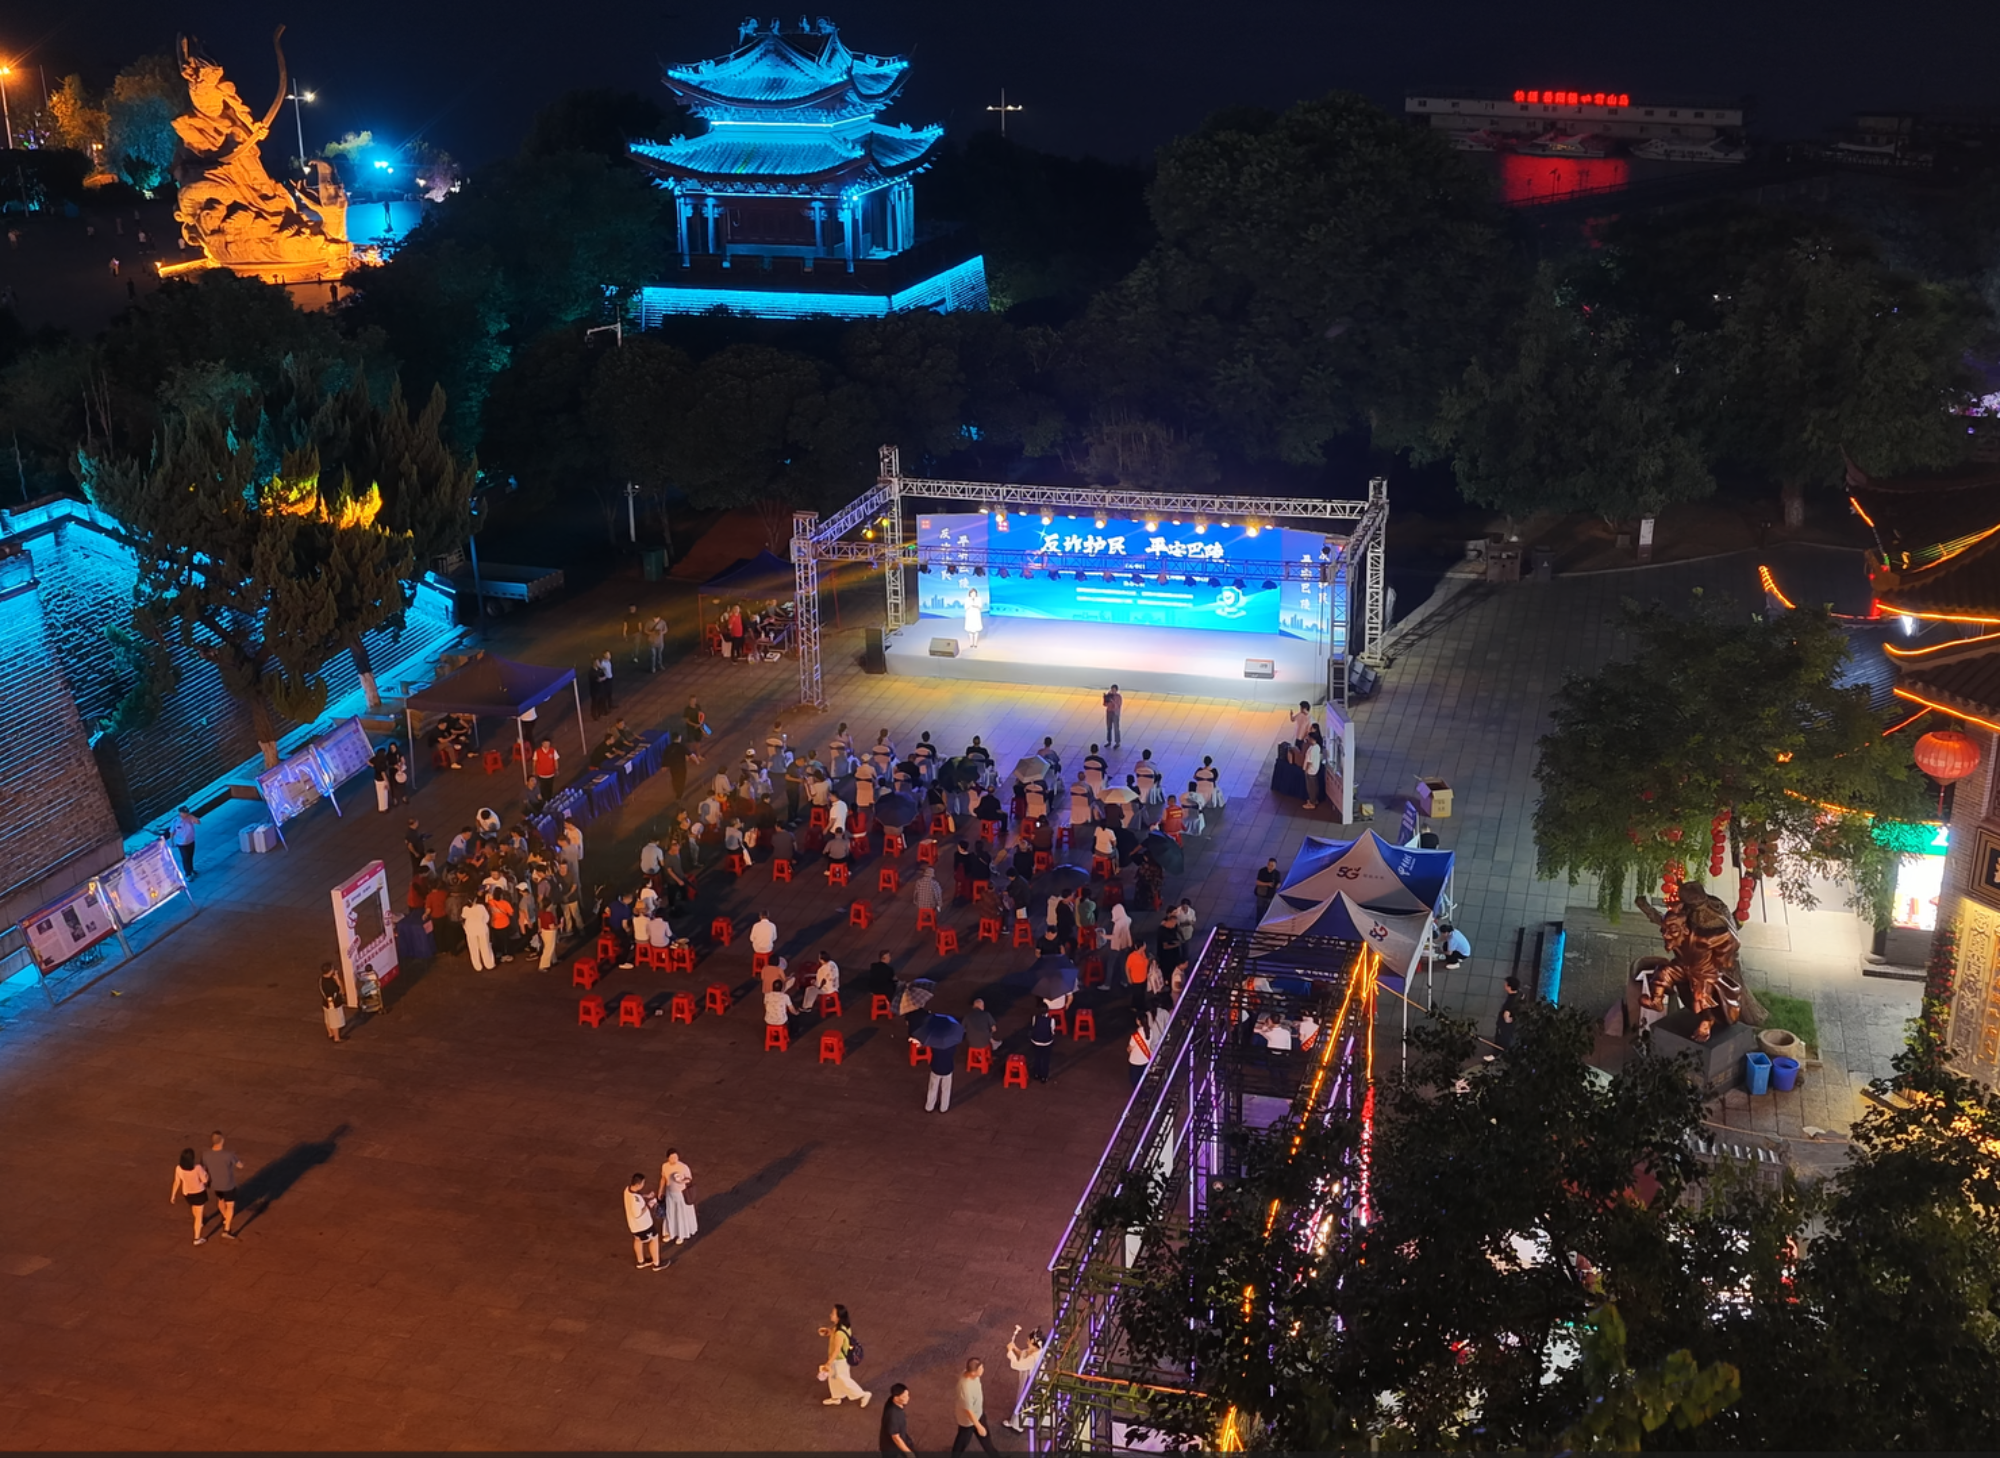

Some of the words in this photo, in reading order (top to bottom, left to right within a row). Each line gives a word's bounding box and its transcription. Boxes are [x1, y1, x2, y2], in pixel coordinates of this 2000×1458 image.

[1041, 533, 1127, 556] 反诈护民
[1336, 866, 1361, 880] 5G
[1369, 921, 1389, 942] 5G
